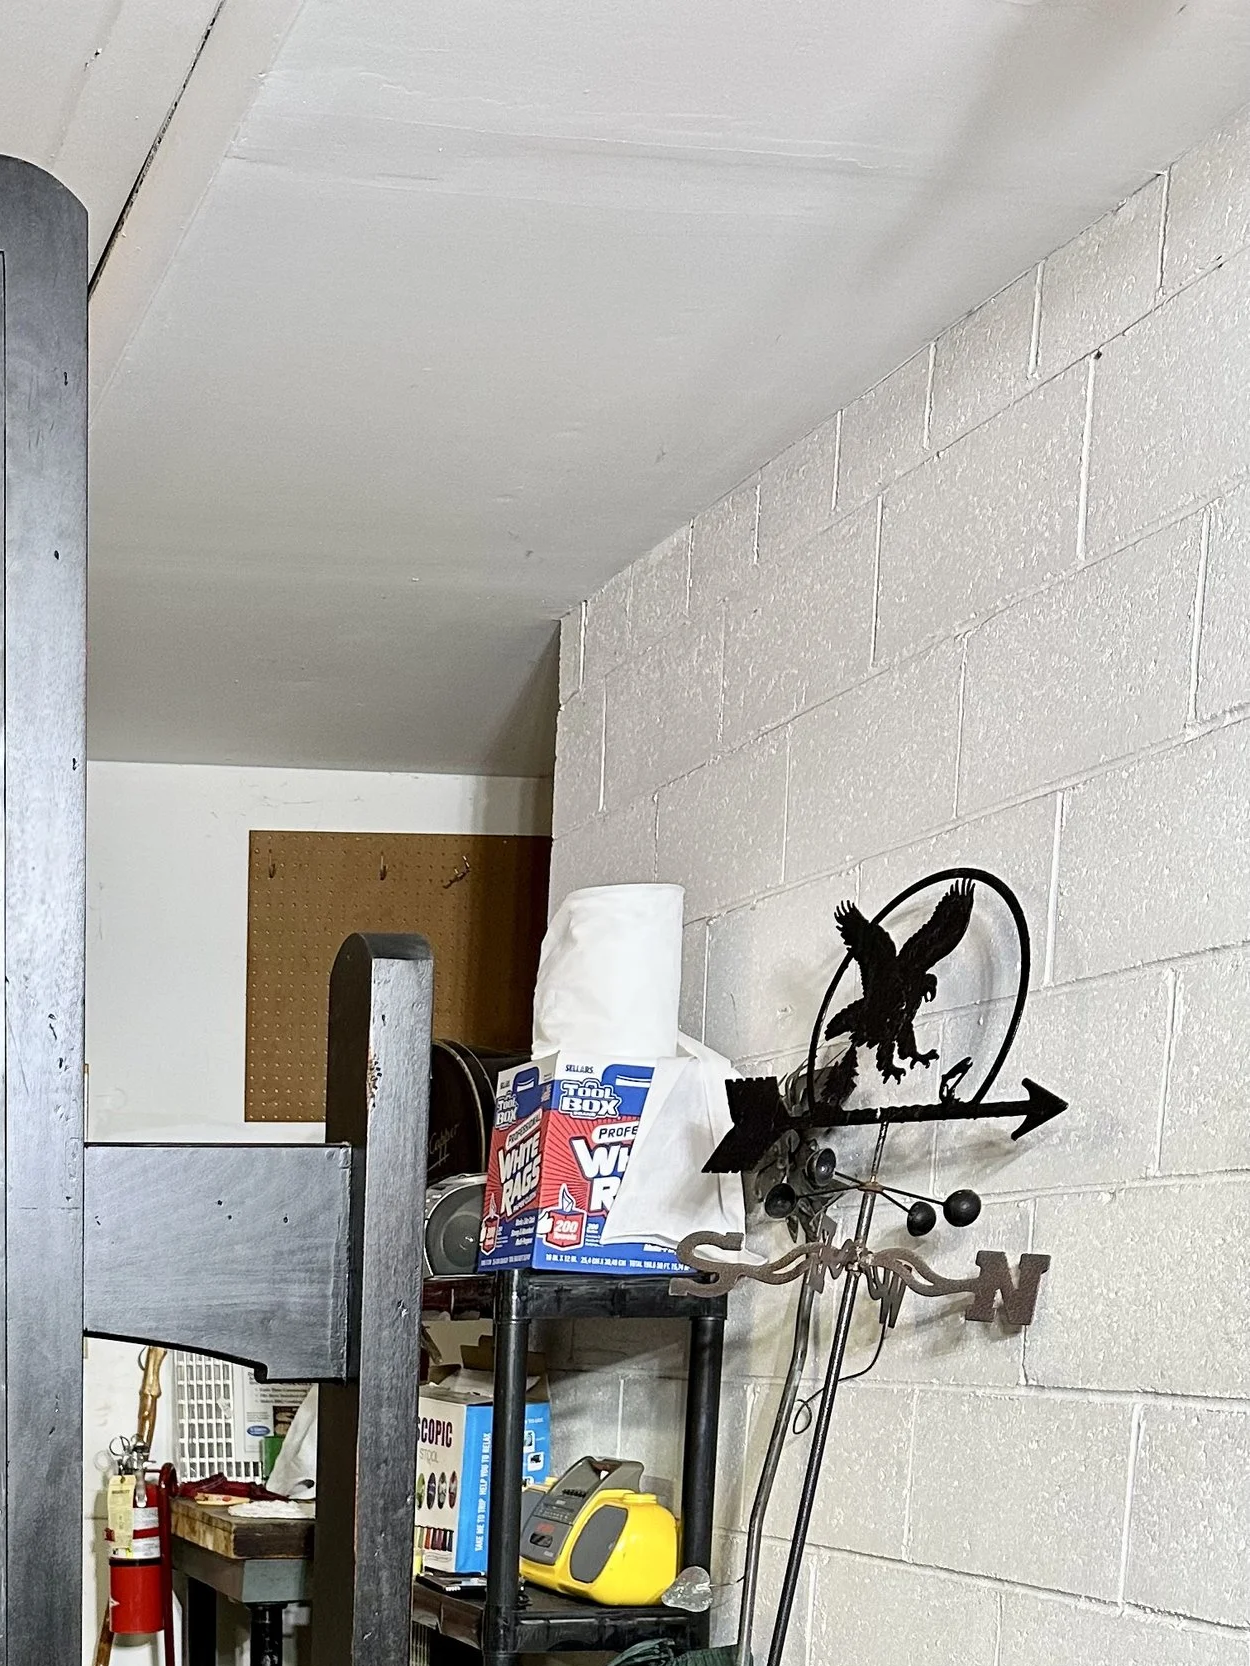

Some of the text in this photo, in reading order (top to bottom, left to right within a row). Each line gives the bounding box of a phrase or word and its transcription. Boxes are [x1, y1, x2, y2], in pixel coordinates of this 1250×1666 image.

[565, 1064, 594, 1074] SELLARS
[563, 1082, 616, 1100] TOOL
[562, 1098, 619, 1116] BOX
[498, 1131, 541, 1184] WHITE
[500, 1156, 541, 1217] RAGS
[555, 1220, 579, 1233] 200
[965, 1250, 1051, 1326] N
[481, 1454, 490, 1463] TO
[479, 1478, 488, 1496] HELP
[477, 1514, 485, 1523] TO
